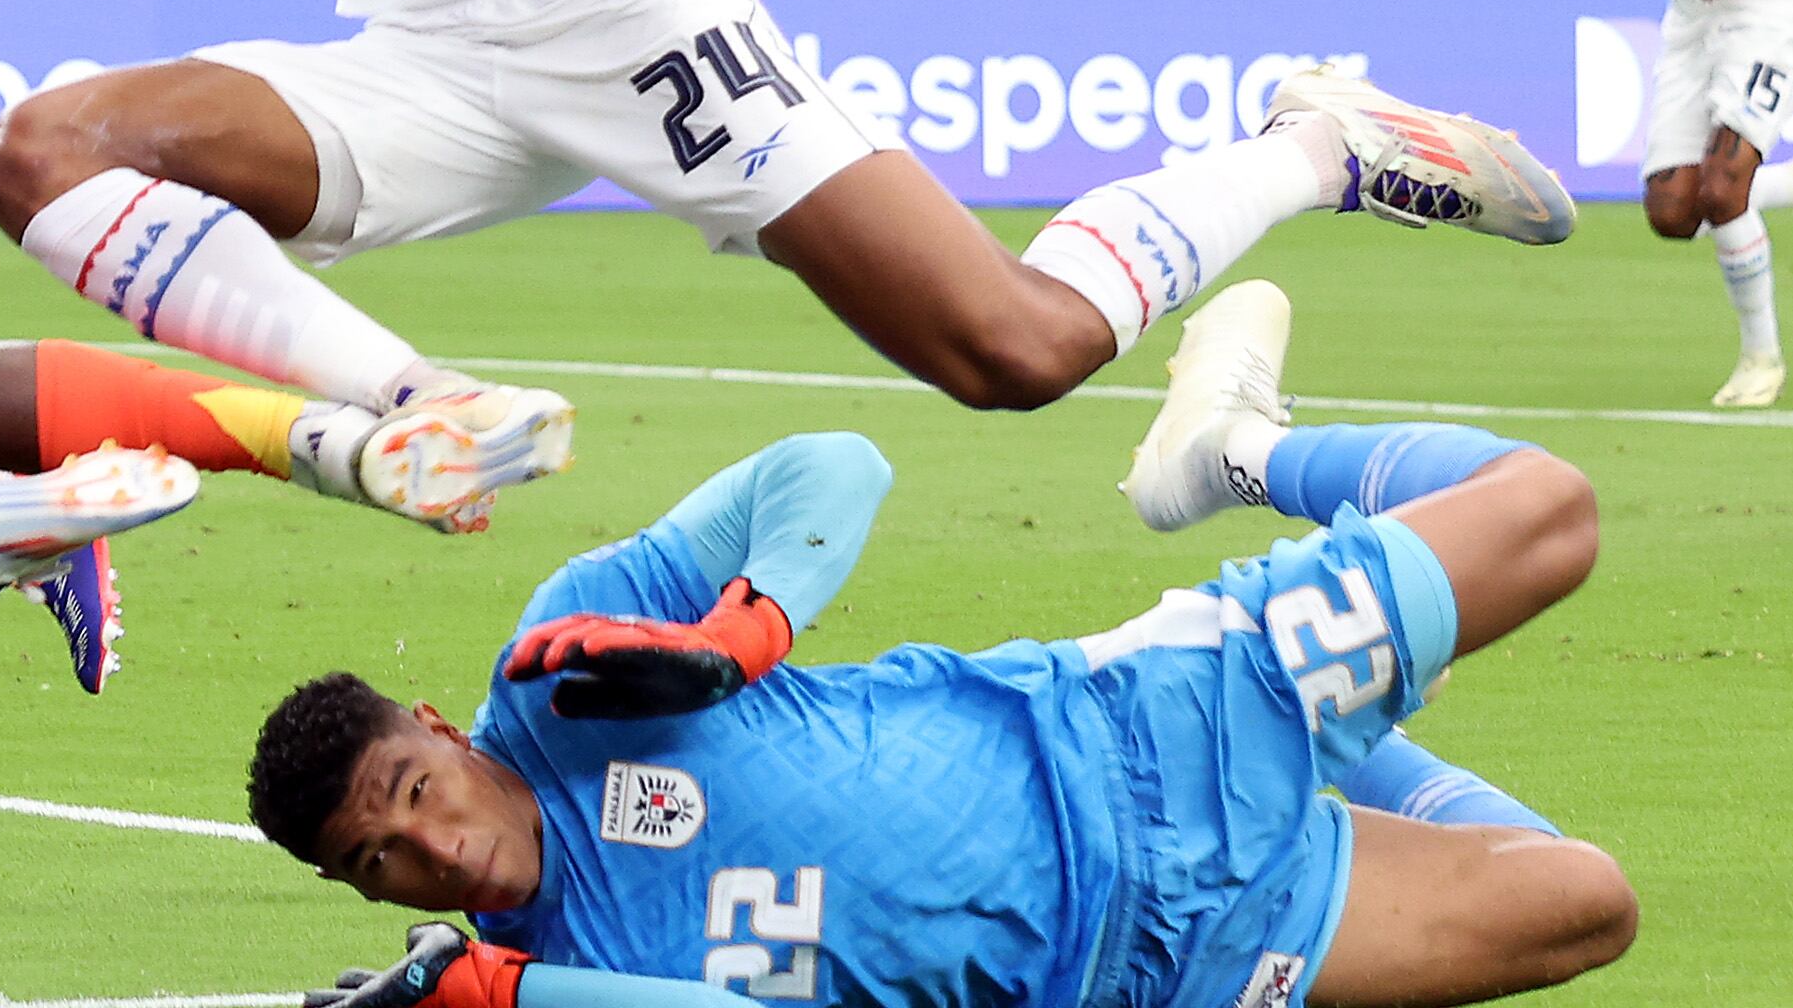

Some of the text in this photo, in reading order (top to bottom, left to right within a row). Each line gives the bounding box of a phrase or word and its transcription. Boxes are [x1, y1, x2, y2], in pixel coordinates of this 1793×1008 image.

[629, 20, 807, 175] 24
[794, 32, 1368, 176] espeg
[1745, 59, 1787, 113] 15
[1264, 567, 1396, 734] 22
[704, 867, 824, 1000] 22
